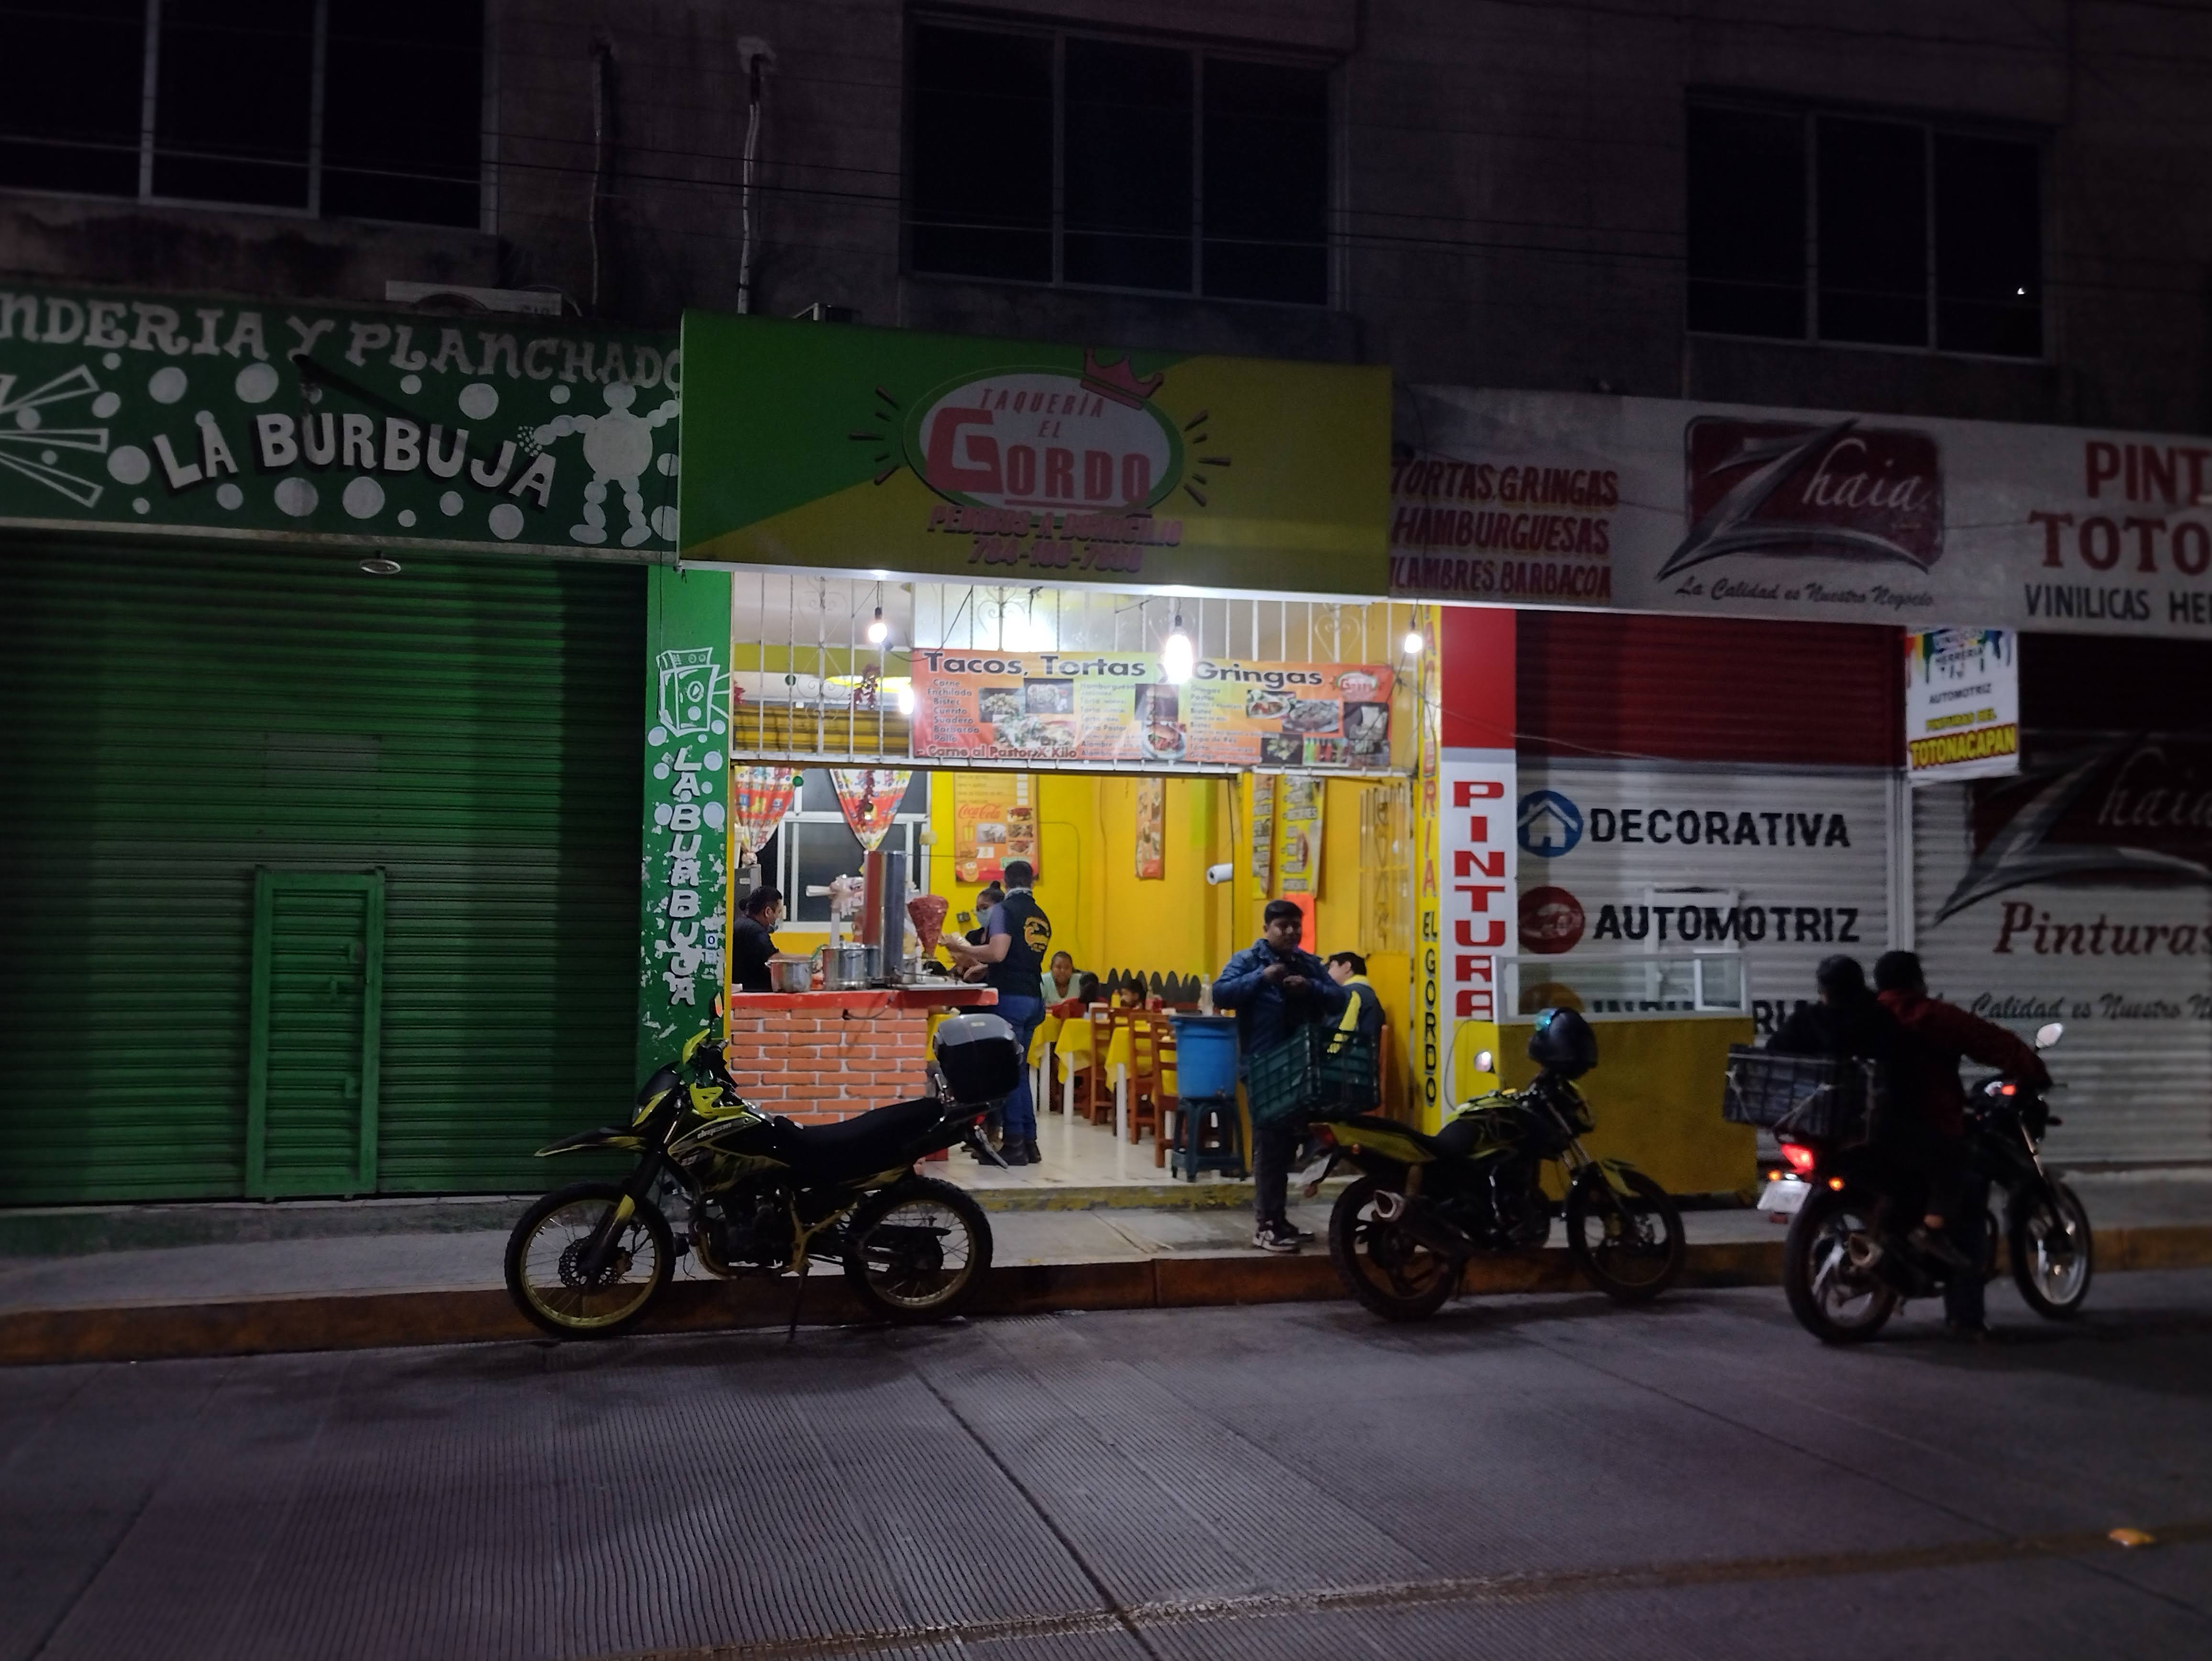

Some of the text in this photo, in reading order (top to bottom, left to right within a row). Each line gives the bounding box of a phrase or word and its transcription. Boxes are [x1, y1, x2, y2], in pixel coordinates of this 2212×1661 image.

[287, 315, 334, 362] Y
[1038, 421, 1062, 438] EL
[153, 412, 556, 509] LA BURBUJA
[926, 407, 1150, 504] GORDO
[2086, 441, 2212, 506] PINT
[1499, 466, 1618, 506] GRINGAS
[1392, 507, 1609, 554] HAMBURGUESAS
[2028, 509, 2211, 576] TOTO
[1501, 561, 1611, 599] BARBACOA
[1676, 576, 1933, 611] La Calidad es Nuestro Negocio
[2025, 583, 2150, 621] VINILICAS
[924, 653, 1028, 676] Tacos,
[1041, 655, 1145, 677] Tortas
[1194, 661, 1323, 688] Gringas
[1929, 683, 1991, 704] AUTOMOTRIZ
[928, 746, 968, 756] Carne
[973, 745, 985, 756] al
[1052, 747, 1077, 758] Kilo
[1909, 724, 2016, 769] TOTONACAPAN
[1590, 808, 1851, 847] DECORATIVA
[1453, 781, 1505, 1018] PINTURA
[1423, 911, 1437, 941] EL
[1593, 904, 1860, 942] AUTOMOTRIZ
[1971, 992, 2064, 1019] Calidad
[2071, 1004, 2091, 1019] es
[2099, 993, 2181, 1019] Nuestro
[1423, 949, 1437, 1107] GORDO
